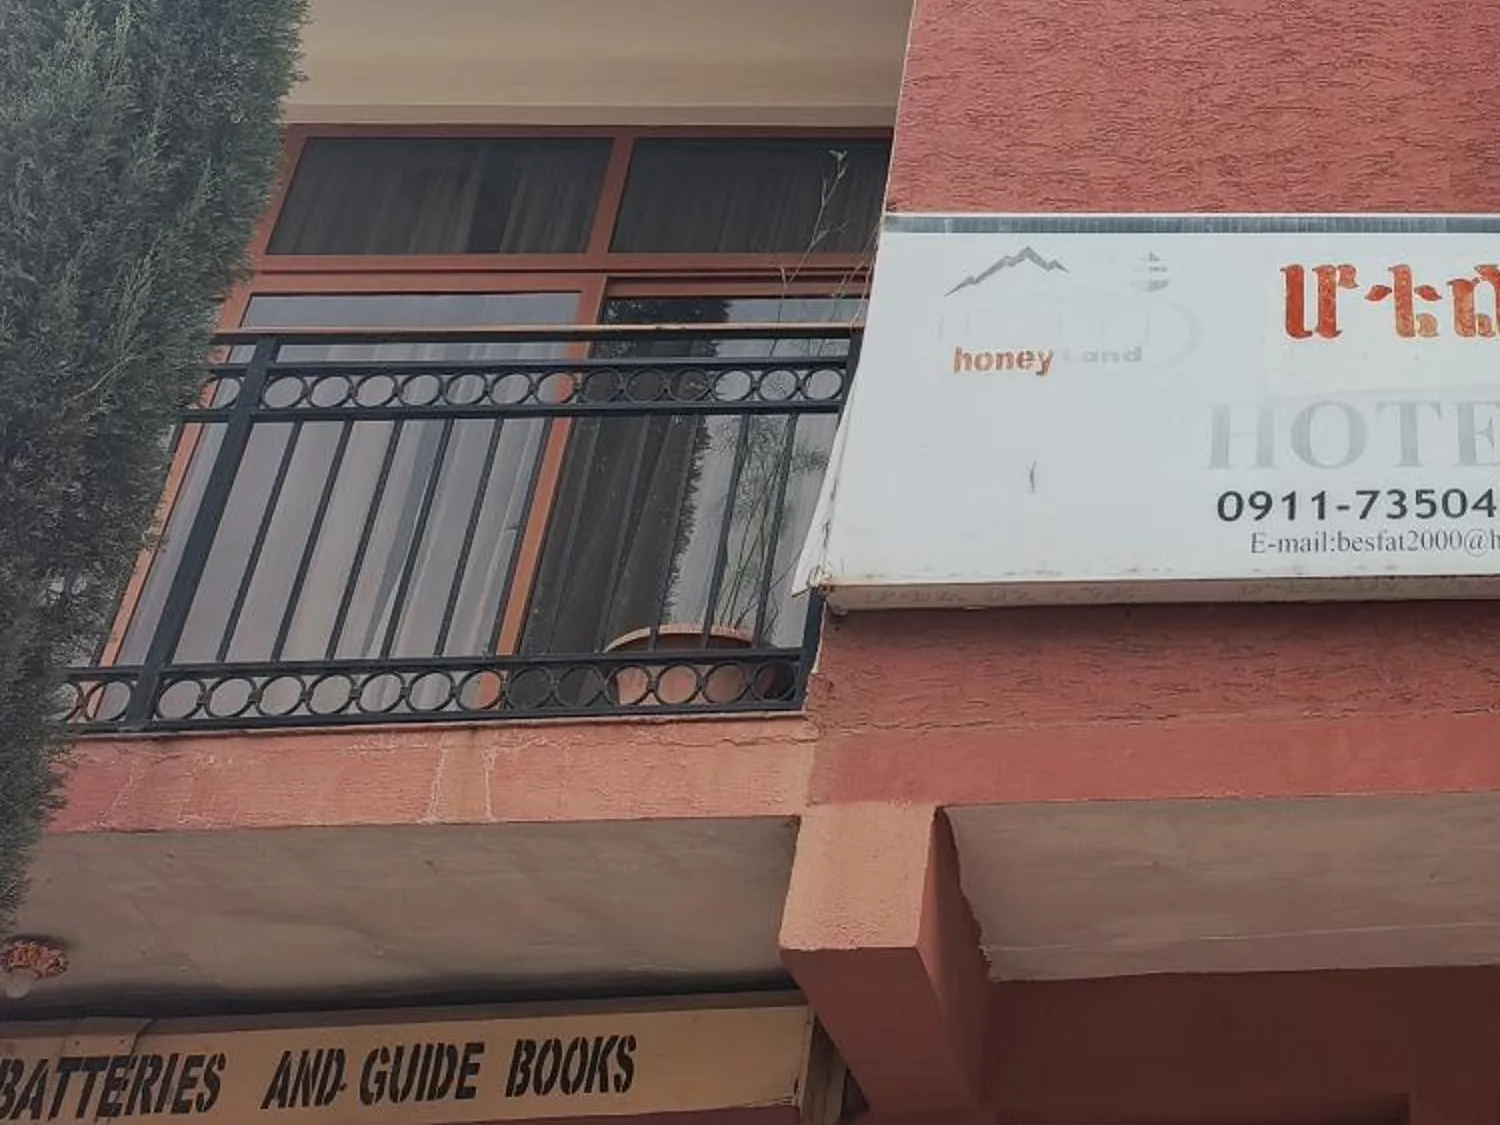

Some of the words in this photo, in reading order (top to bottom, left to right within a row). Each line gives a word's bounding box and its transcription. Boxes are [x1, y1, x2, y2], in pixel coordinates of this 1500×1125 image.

[953, 346, 1055, 376] honey
[0, 1052, 227, 1121] BATTERIES
[260, 1047, 347, 1110] AND
[359, 1041, 486, 1106] GUIDE
[504, 1034, 638, 1098] BOOKS
